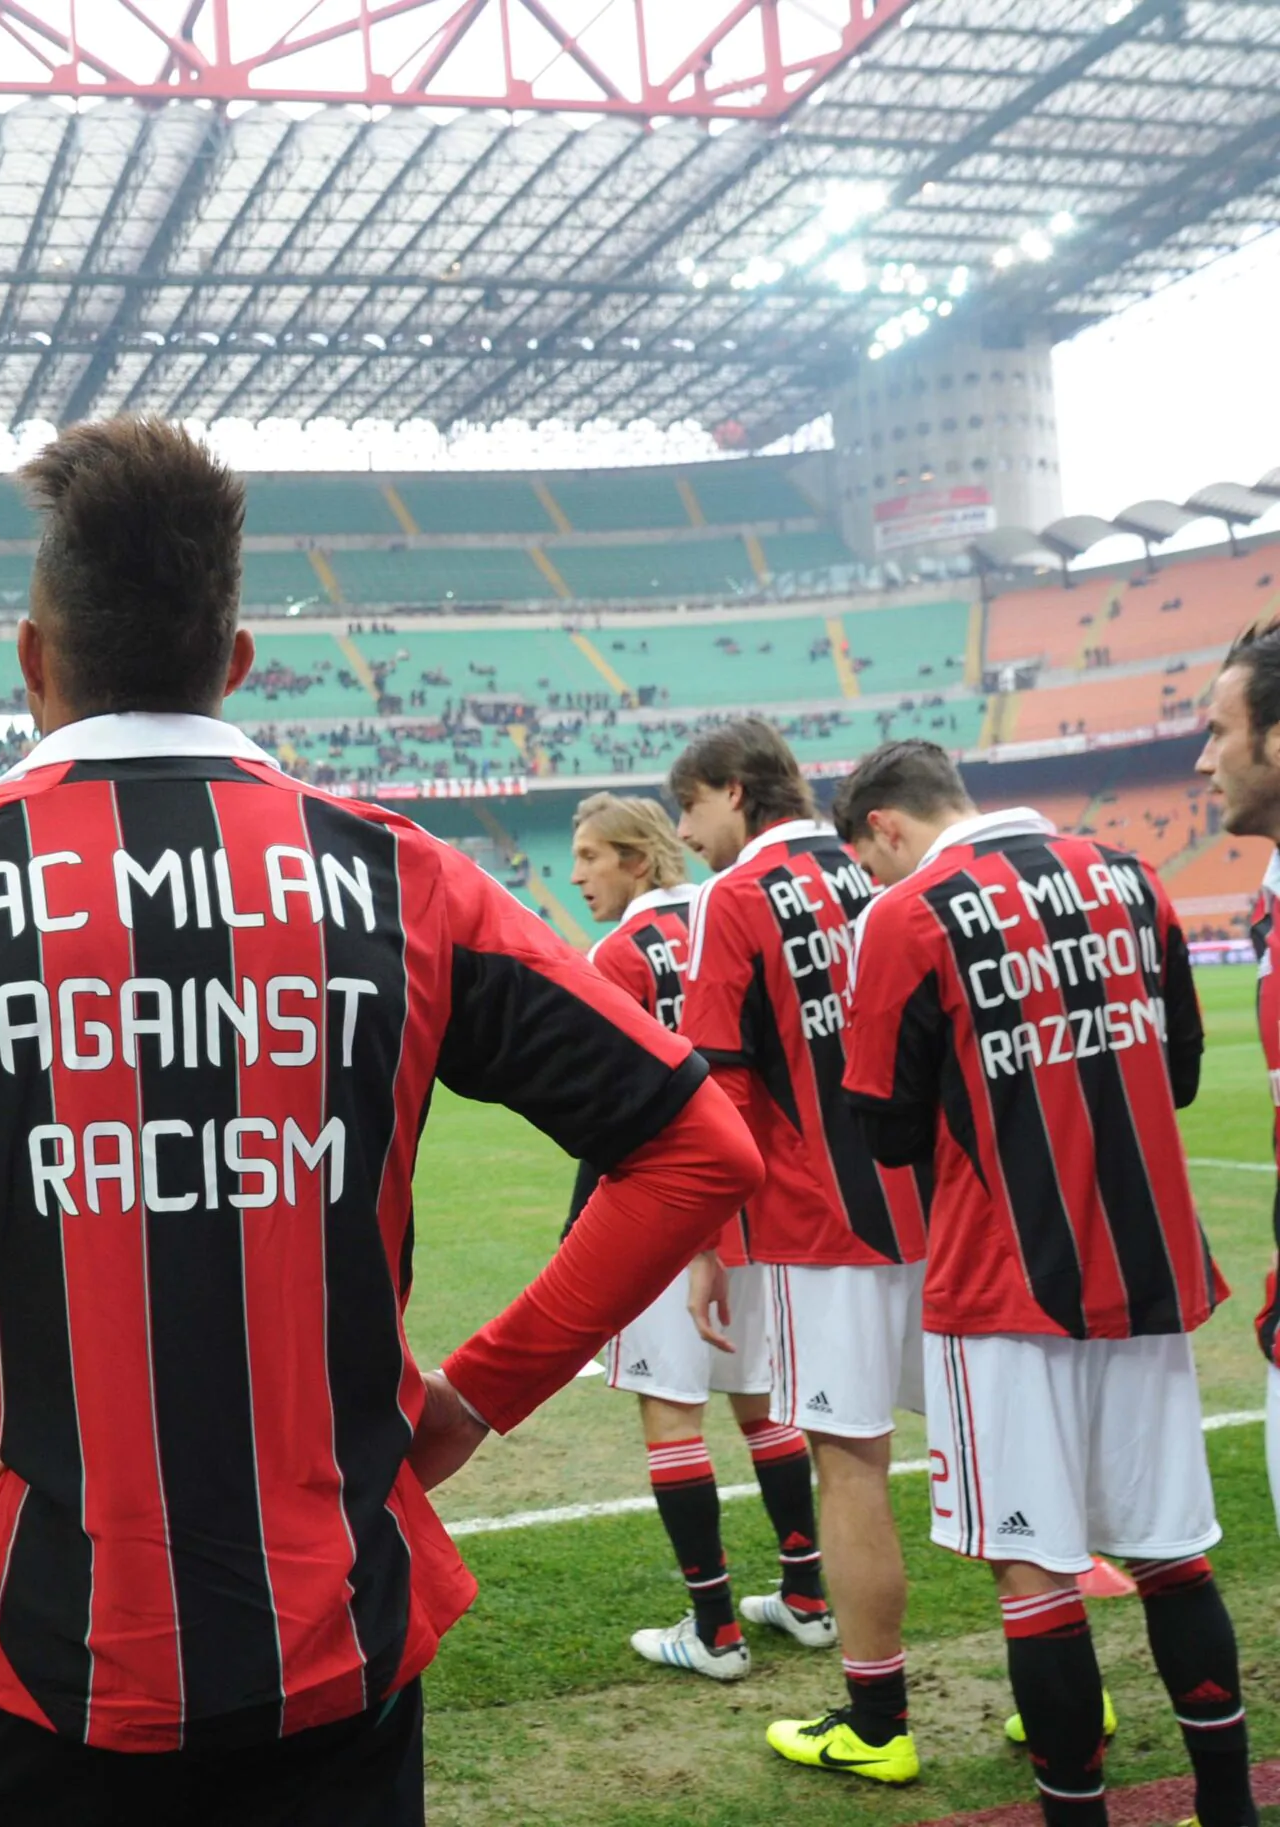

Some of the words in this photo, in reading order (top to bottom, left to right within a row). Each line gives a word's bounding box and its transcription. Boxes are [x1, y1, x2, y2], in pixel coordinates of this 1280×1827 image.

[112, 844, 377, 933] MILAN
[769, 874, 824, 920] AC
[949, 884, 1020, 938] AC
[1017, 862, 1145, 921] MILAN
[646, 939, 688, 976] AC
[968, 928, 1137, 1009] CONTRO
[28, 1115, 347, 1217] RACISM
